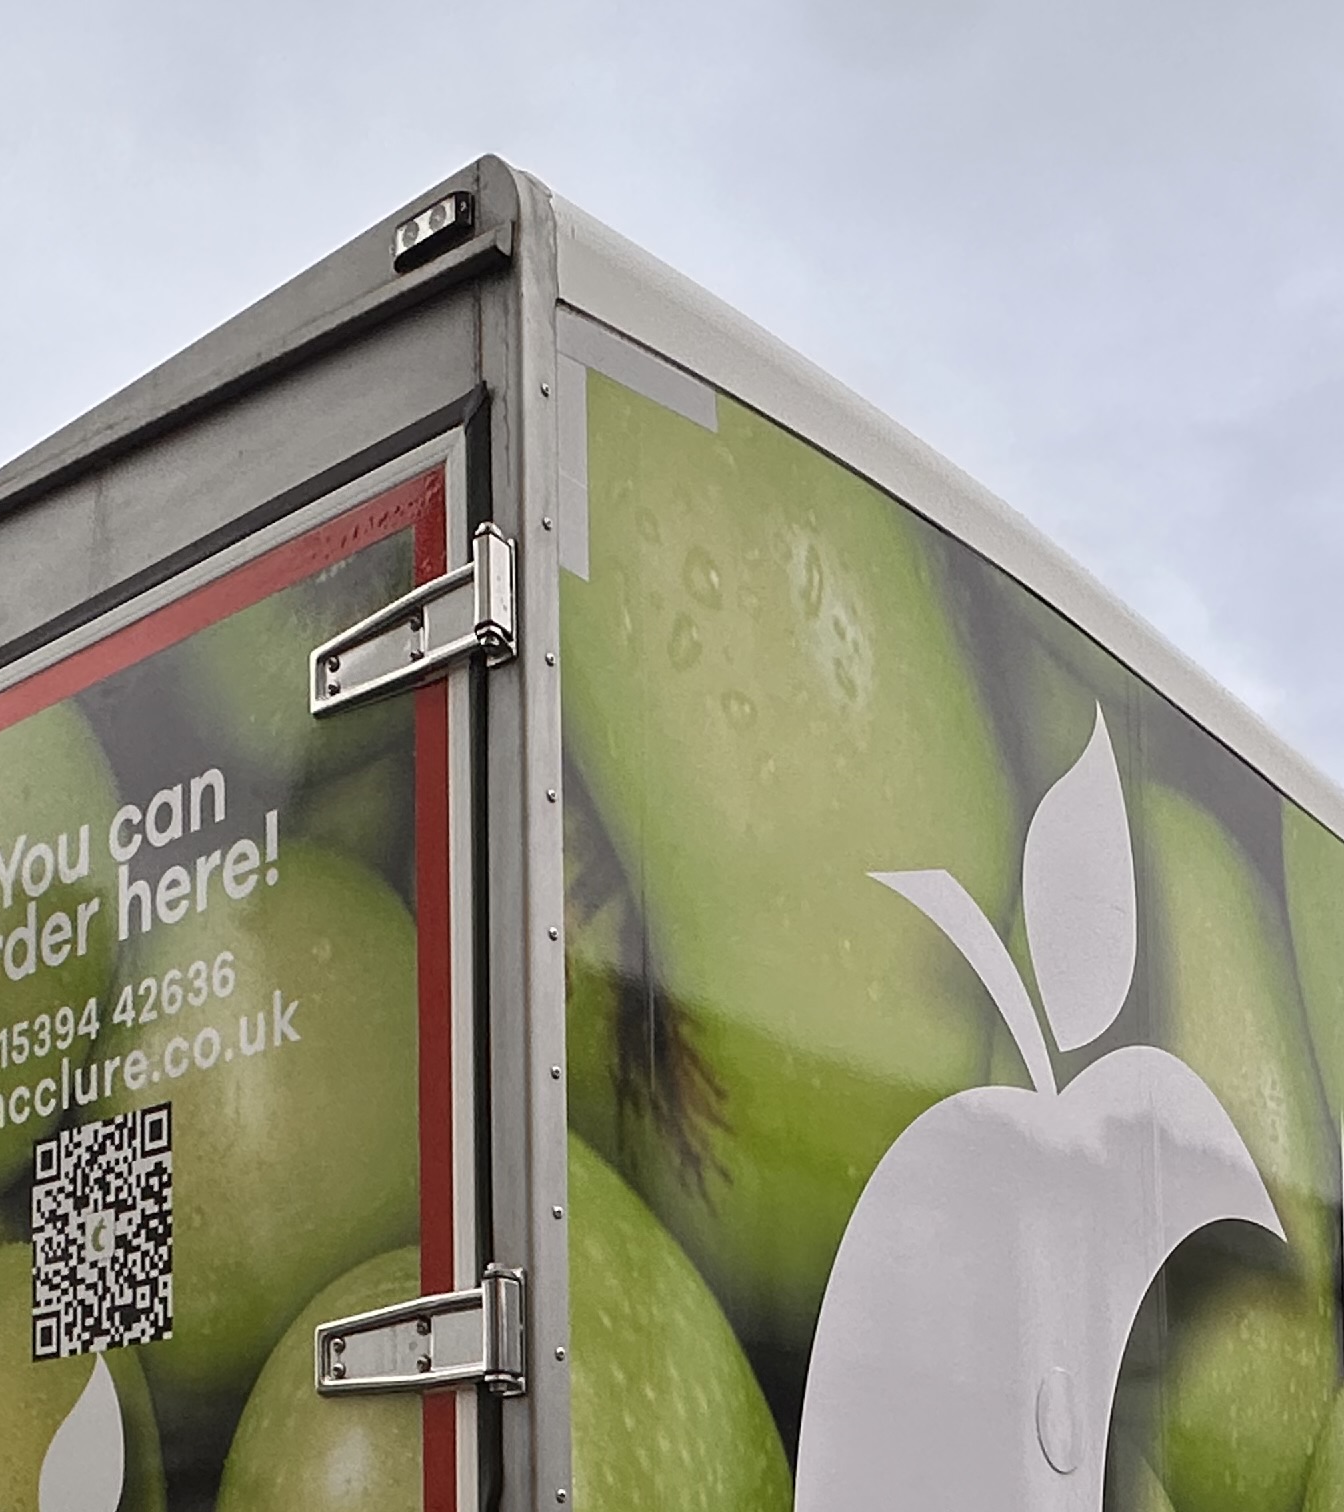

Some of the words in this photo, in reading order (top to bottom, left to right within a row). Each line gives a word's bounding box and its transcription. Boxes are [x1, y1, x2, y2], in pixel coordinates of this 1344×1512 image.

[109, 768, 225, 862] can
[118, 809, 278, 941] here!
[112, 951, 235, 1028] 42636
